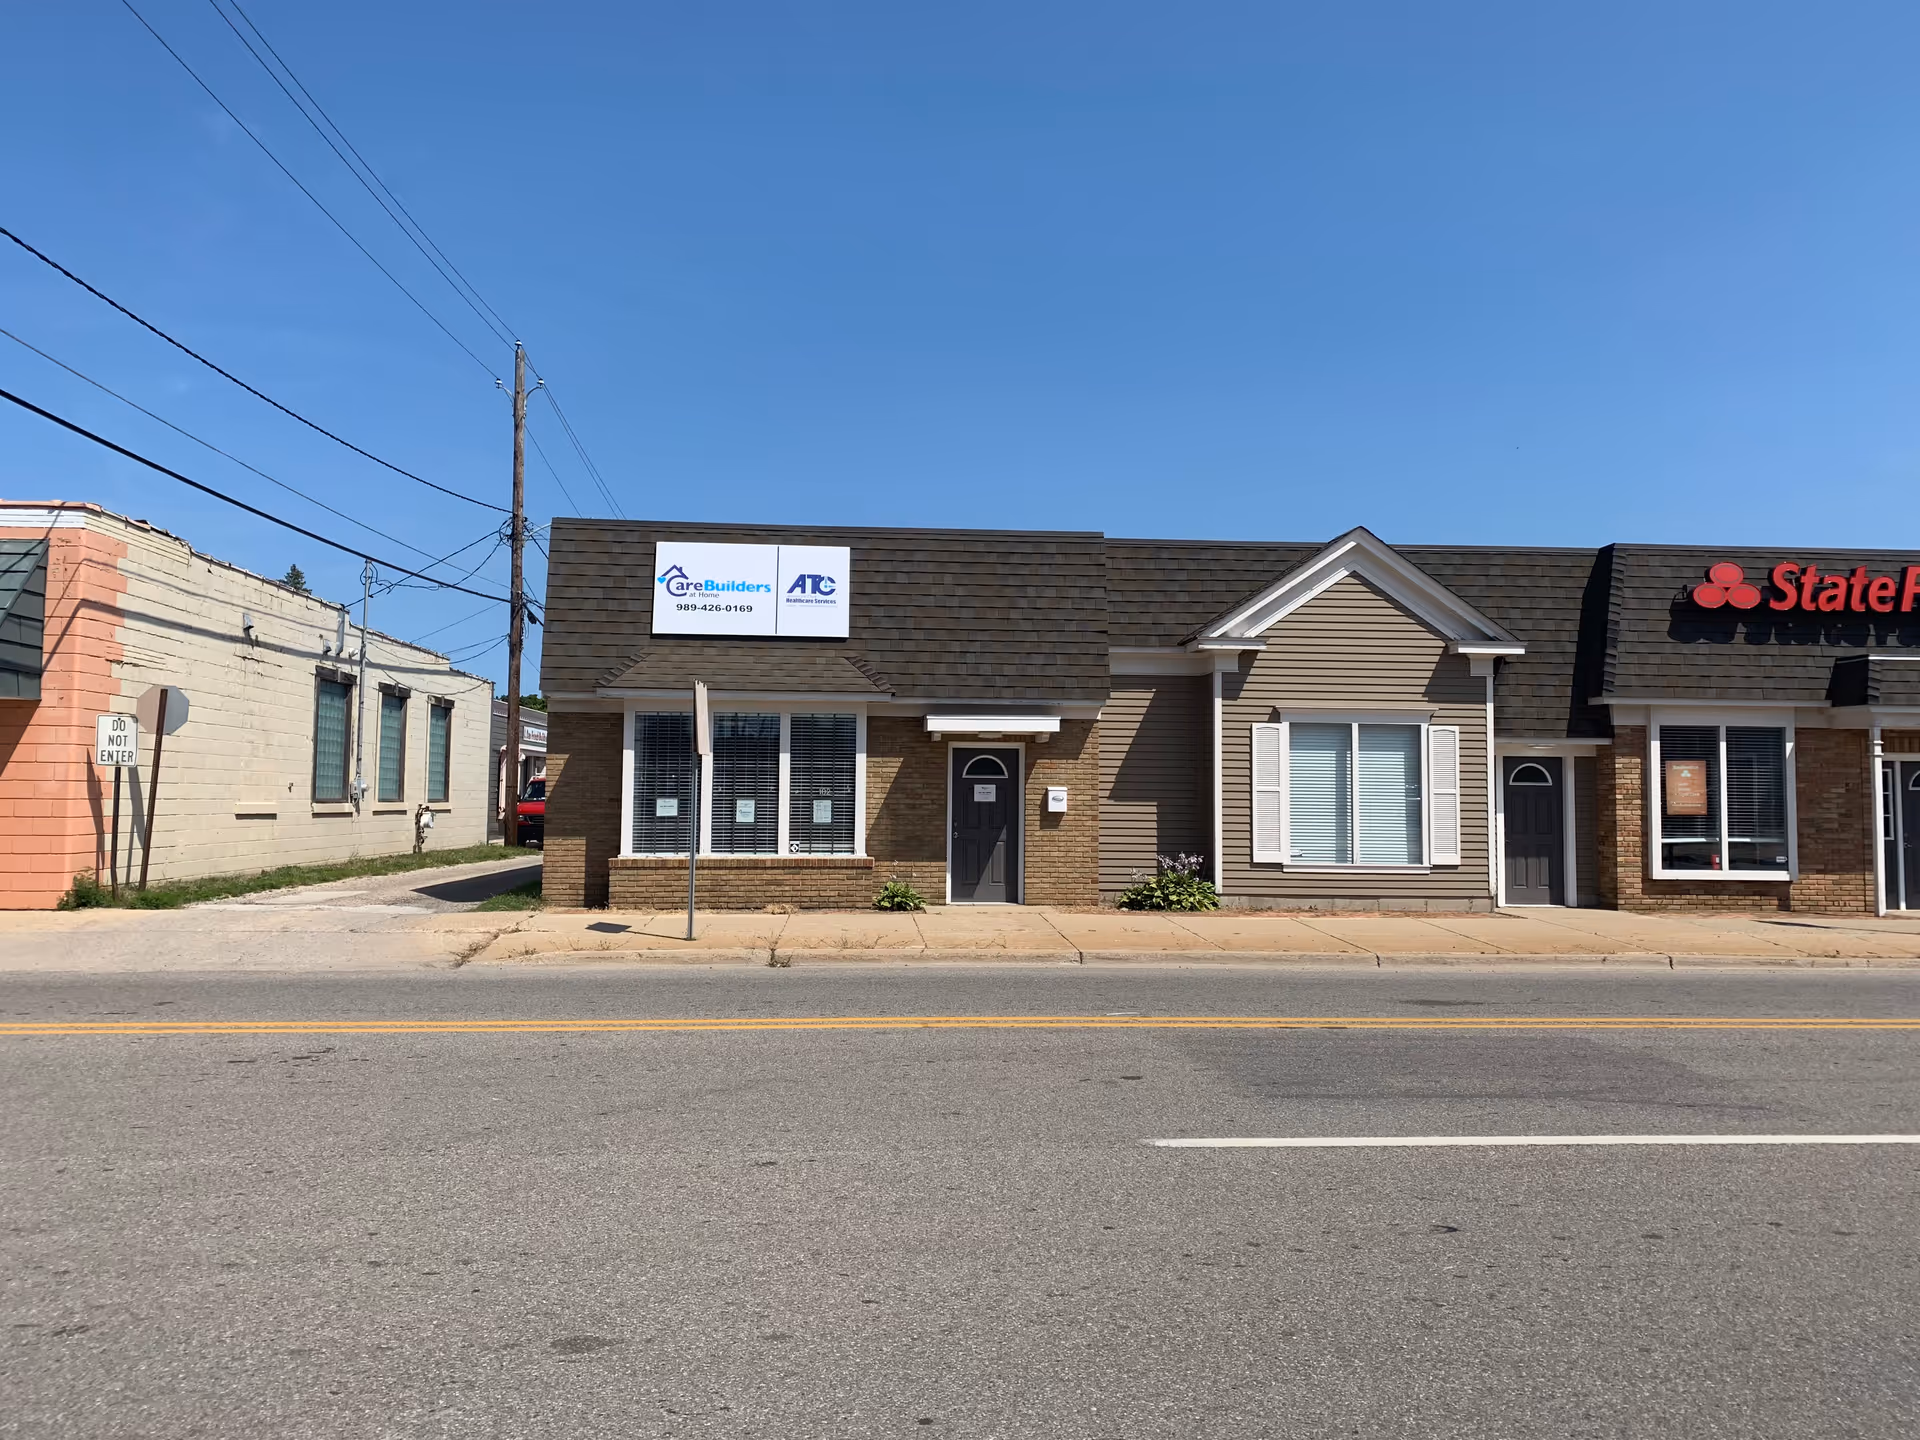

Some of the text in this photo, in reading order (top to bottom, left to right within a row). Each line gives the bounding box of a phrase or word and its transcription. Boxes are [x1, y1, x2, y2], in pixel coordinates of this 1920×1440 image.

[666, 574, 771, 597] CareBuilders
[787, 574, 836, 596] ATC
[1769, 562, 1896, 612] State
[676, 604, 753, 612] 989-426-0169
[112, 720, 126, 731] DO
[108, 735, 128, 746] NOT
[101, 750, 134, 762] ENTER
